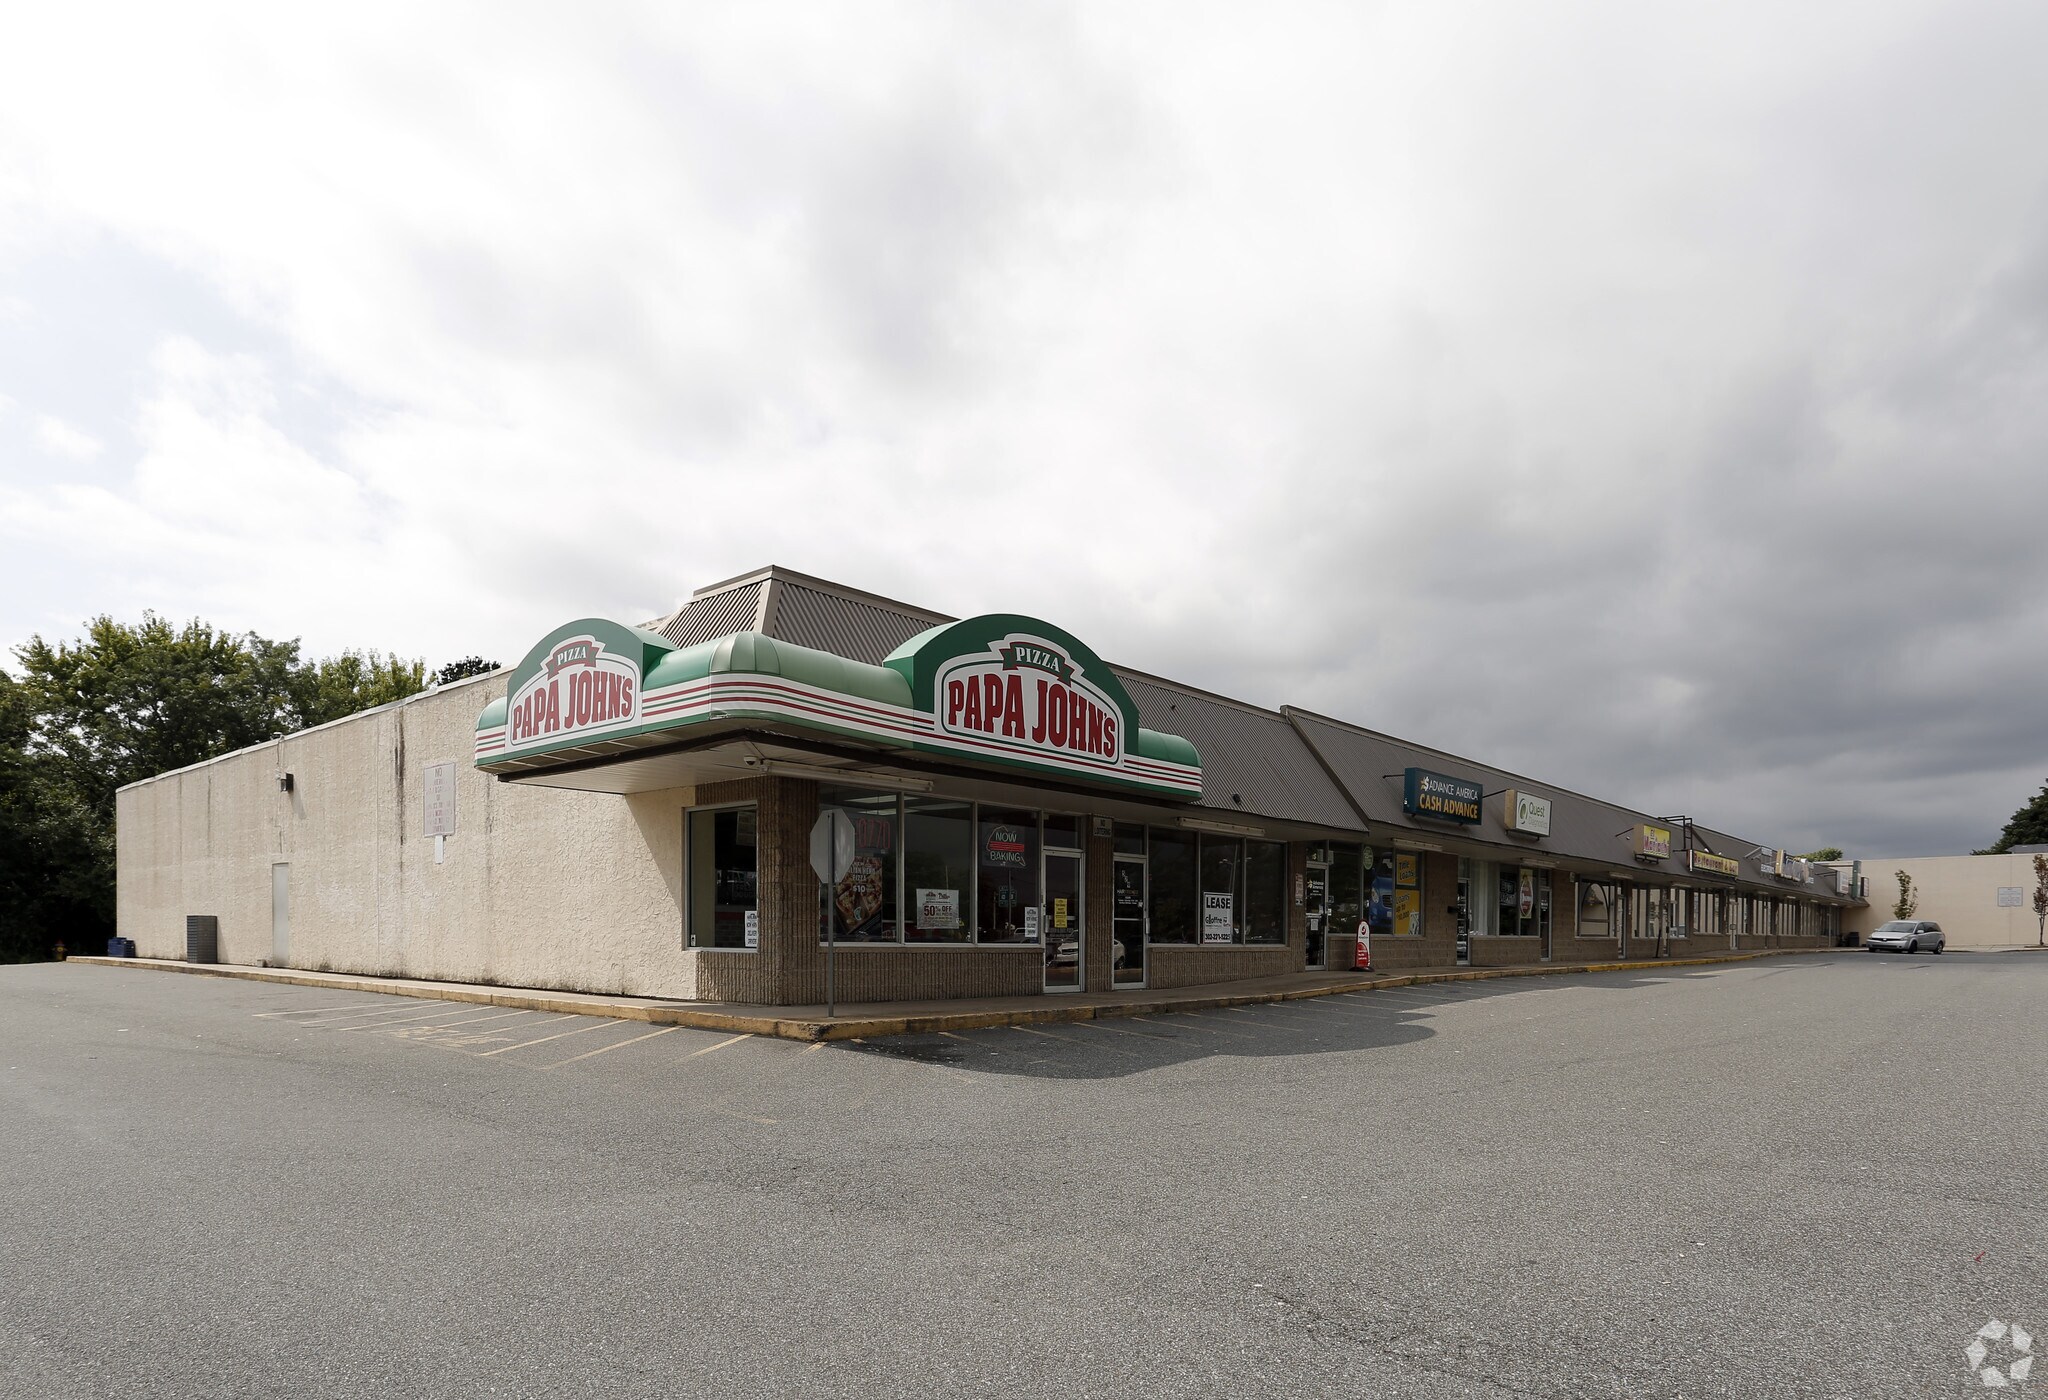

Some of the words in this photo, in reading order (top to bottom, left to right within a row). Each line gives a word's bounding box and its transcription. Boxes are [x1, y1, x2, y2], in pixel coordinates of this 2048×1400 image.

[557, 646, 587, 667] PIZZA
[1015, 646, 1060, 672] PIZZA
[513, 681, 560, 740] PAPA
[564, 670, 632, 728] JOHN'S
[948, 675, 1025, 739] PAPA
[1032, 680, 1116, 758] JOHN'S
[1429, 780, 1454, 795] ADVANCE
[1456, 787, 1478, 800] AMERICA
[1419, 793, 1442, 812] CASH
[1443, 799, 1478, 818] ADVANCE
[1529, 802, 1545, 817] Quest
[995, 831, 1017, 842] NOW
[990, 851, 1021, 863] BAKING
[853, 885, 866, 893] $10
[1206, 896, 1231, 909] LEASE
